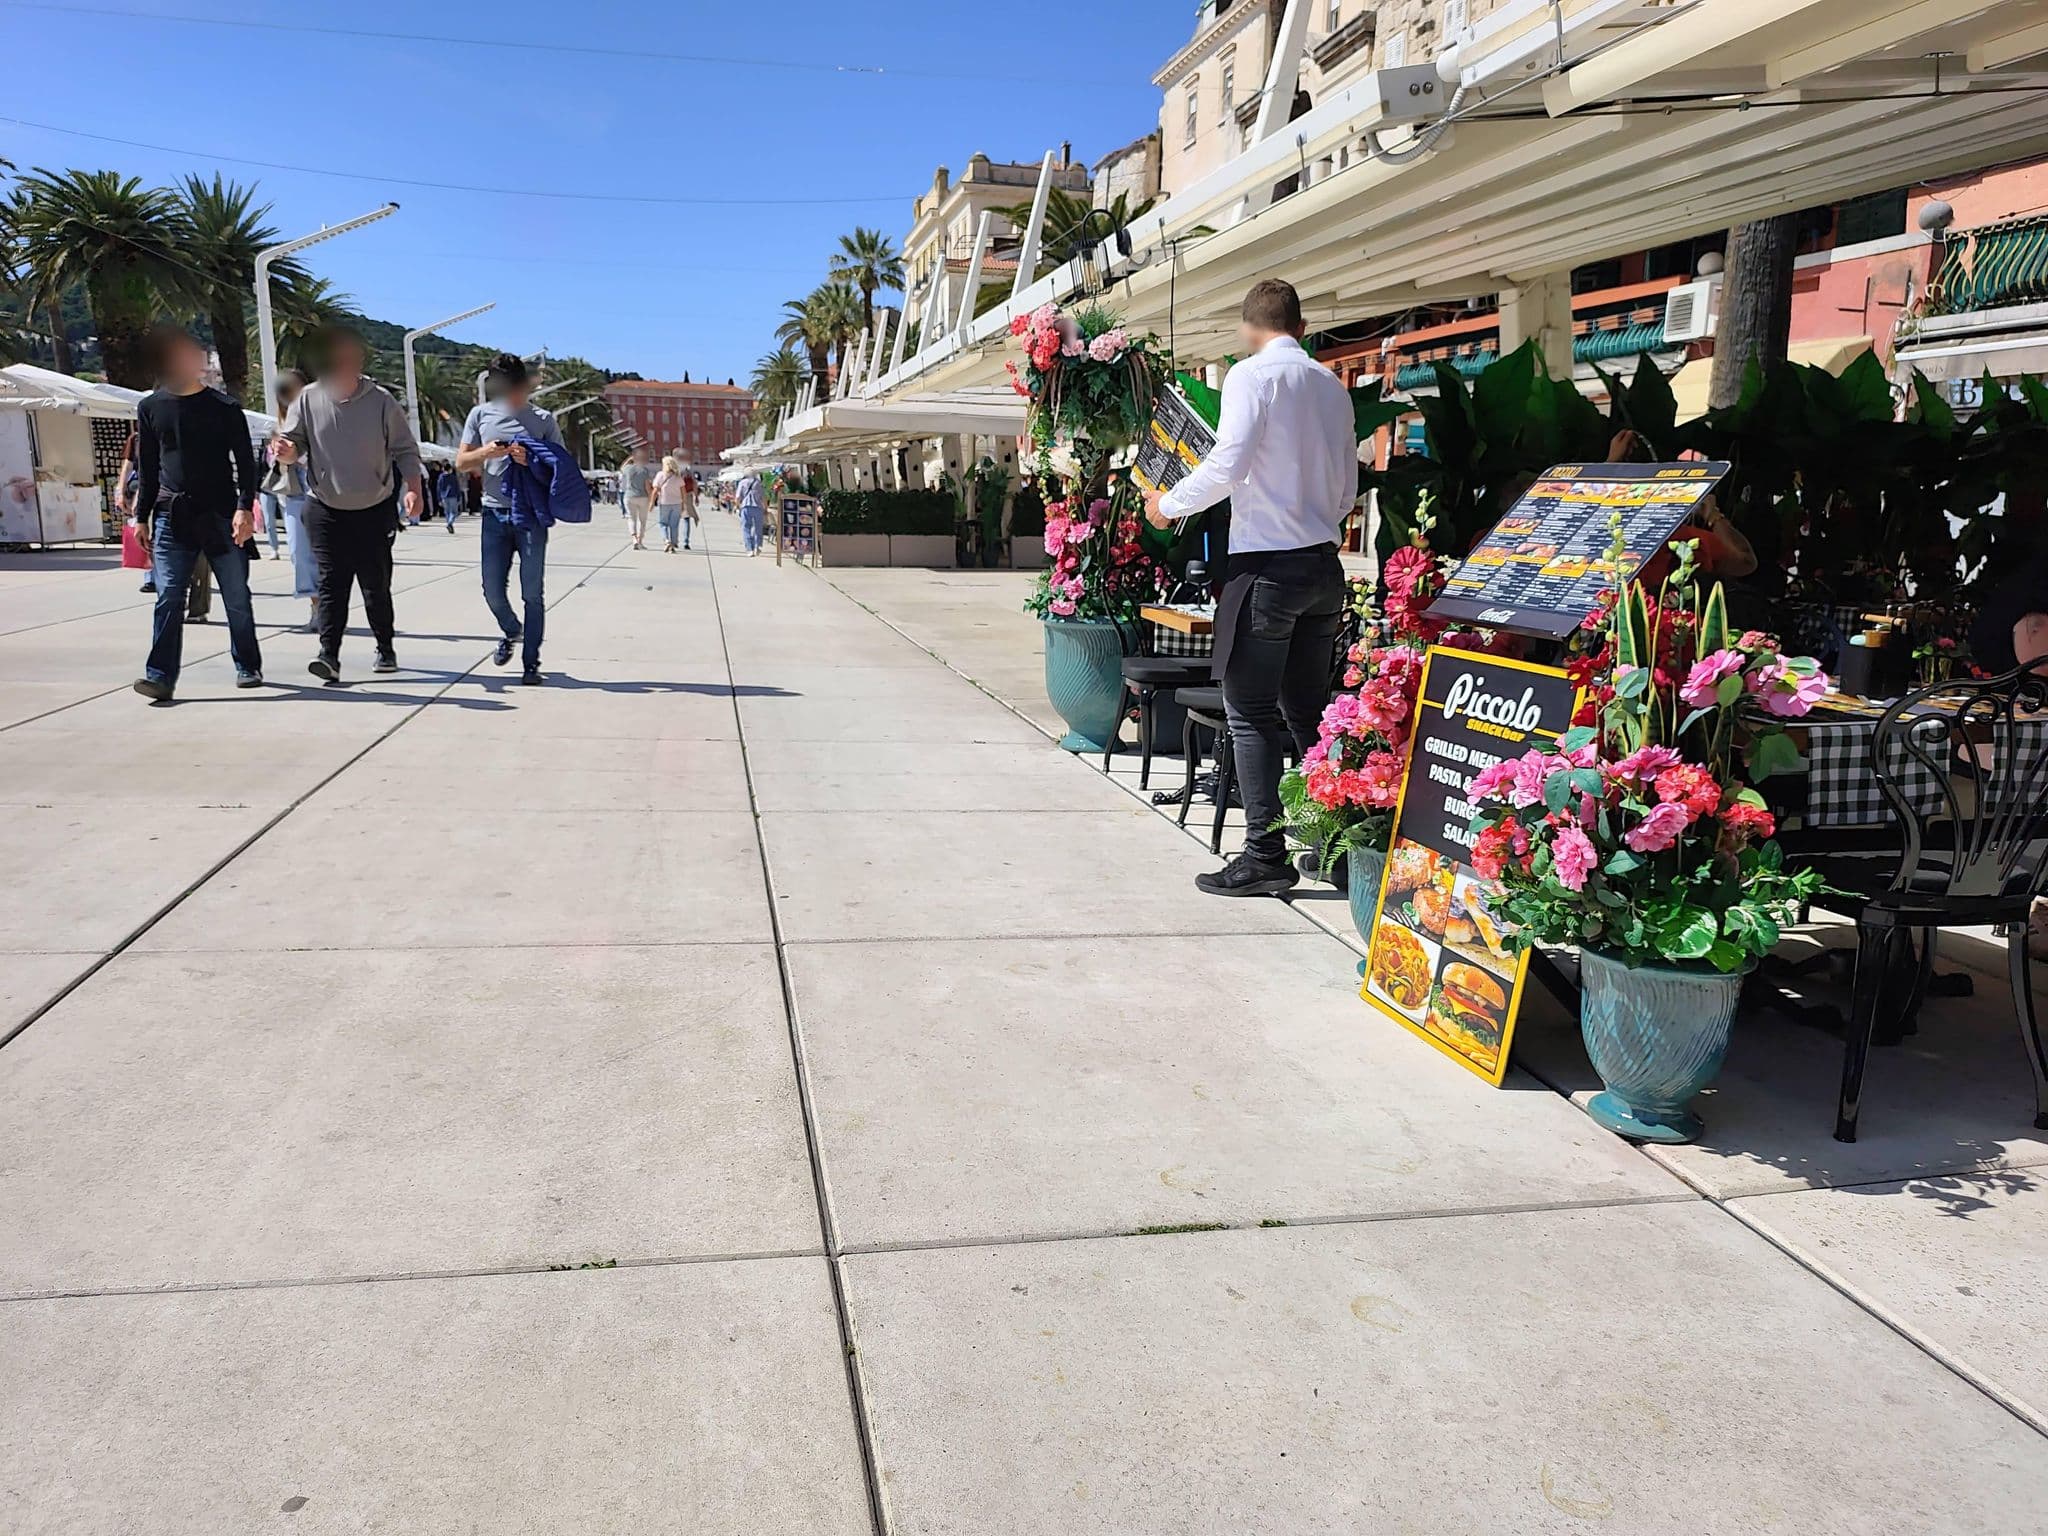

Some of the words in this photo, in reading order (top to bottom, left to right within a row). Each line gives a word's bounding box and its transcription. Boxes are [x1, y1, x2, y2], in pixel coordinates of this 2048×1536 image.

[1444, 674, 1541, 731] Piccolo
[1425, 736, 1468, 762] GRILLED
[1429, 765, 1462, 788] PASTA
